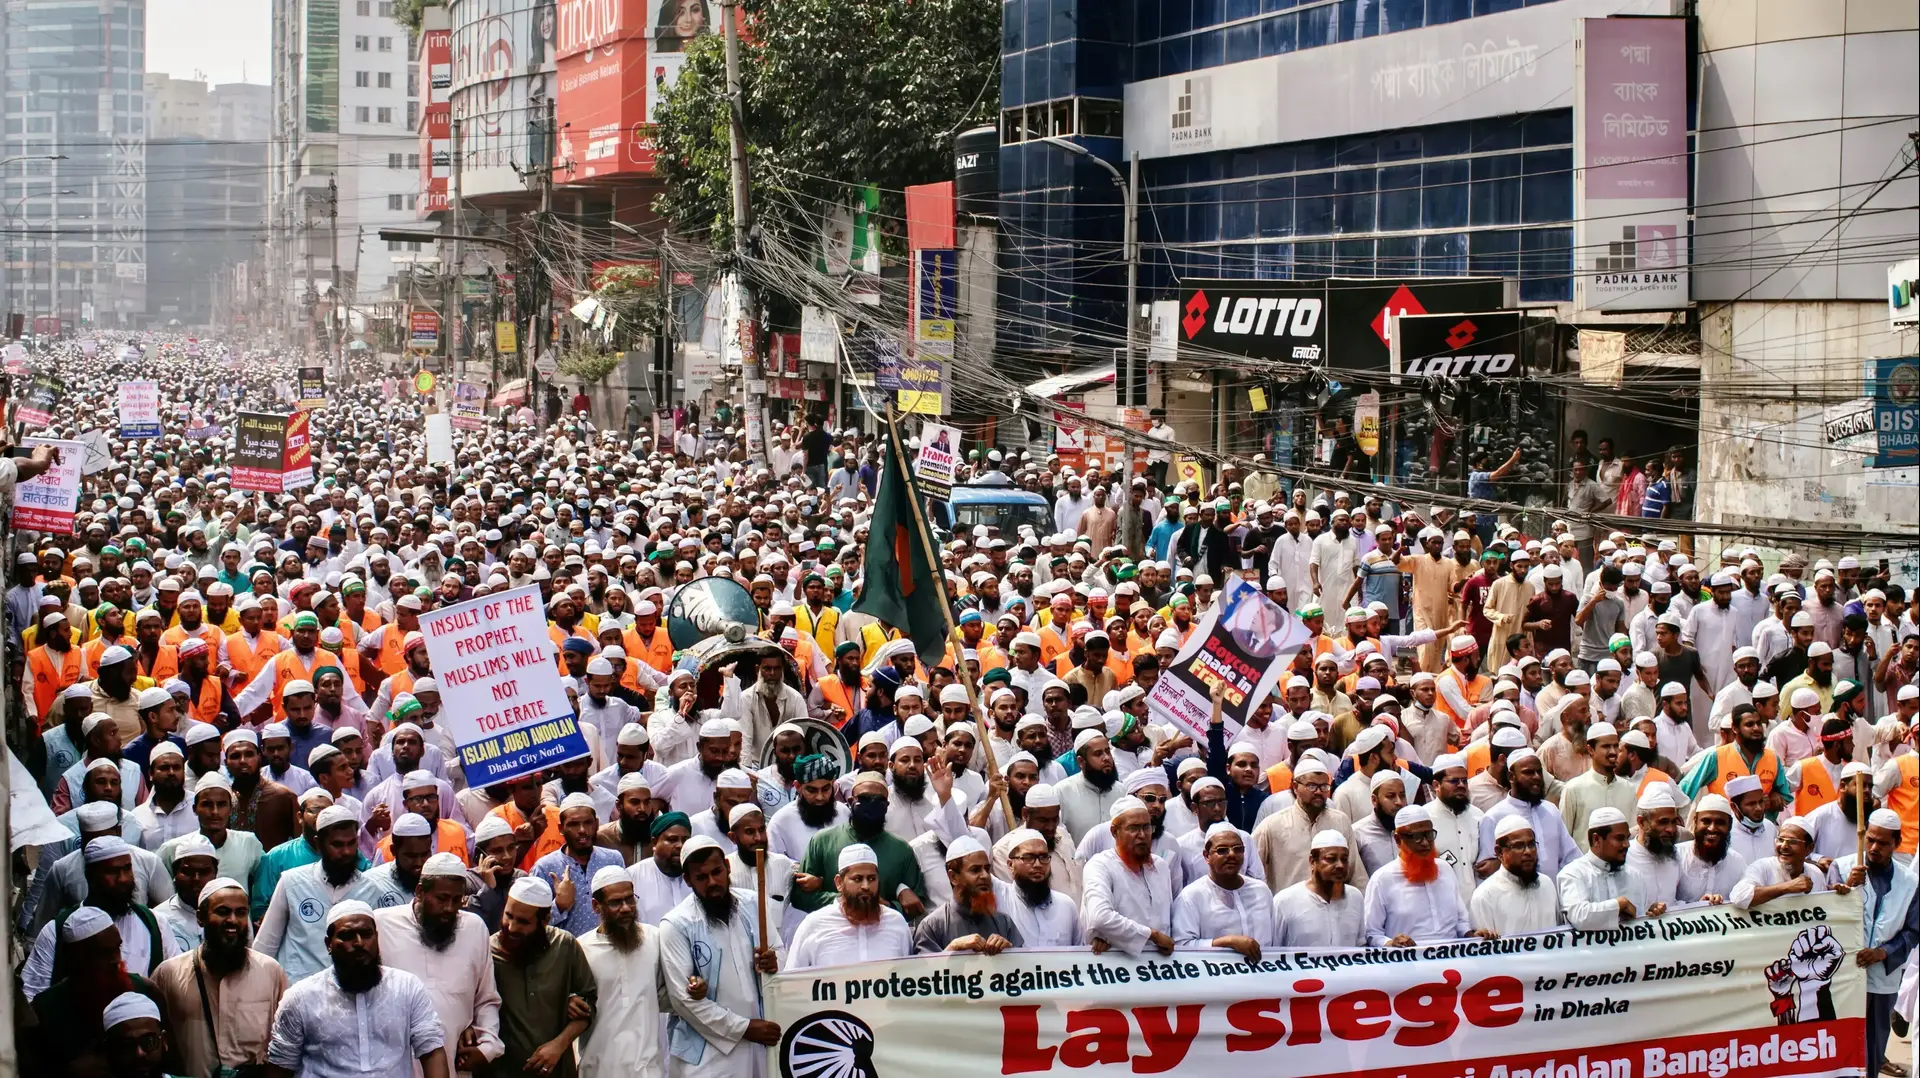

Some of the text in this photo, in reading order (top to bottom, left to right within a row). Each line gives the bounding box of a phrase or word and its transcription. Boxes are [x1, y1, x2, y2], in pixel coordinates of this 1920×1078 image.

[430, 33, 451, 48] rin
[1621, 45, 1652, 64] পদ্মা
[1405, 59, 1456, 97] ব্যাংক
[1460, 36, 1538, 91] লিমিটেড
[1612, 82, 1659, 102] ব্যাংক
[1172, 127, 1212, 142] PADMA BANK
[1602, 113, 1670, 139] লিমিটেড
[956, 154, 977, 169] GAZI
[1593, 155, 1628, 166] LOCKER
[430, 191, 448, 206] rin
[1596, 273, 1678, 284] PADMA BANK
[1213, 297, 1322, 337] LOTTO
[901, 367, 939, 386] GOODYEAR
[1406, 353, 1516, 377] LOTTO
[303, 387, 322, 395] High
[456, 403, 480, 412] Boycott
[244, 418, 258, 428] الله
[240, 449, 256, 458] عيب
[257, 448, 267, 458] كل
[922, 446, 953, 465] France
[920, 459, 952, 474] promoting
[37, 474, 61, 486] সবার
[22, 493, 70, 507] মানবতার
[430, 595, 535, 637] INSULT OF THE
[455, 625, 524, 657] PROPHET,
[444, 647, 546, 688] MUSLIMS WILL
[1205, 636, 1262, 684] Boycott
[1188, 658, 1245, 708] Frace
[1197, 648, 1253, 696] made in
[491, 680, 519, 702] NOT
[476, 700, 548, 735] TOLERATE
[1152, 692, 1172, 710] Islami
[1169, 705, 1194, 727] Andolan
[1190, 721, 1208, 738] Bang
[462, 717, 577, 766] ISLAMI JUBO ANDOLAN
[488, 743, 565, 776] Dhaka City North
[845, 967, 984, 1005] protesting
[990, 962, 1083, 997] against
[1087, 960, 1132, 985] the
[1137, 960, 1200, 982] state
[1202, 953, 1293, 977] backed
[1294, 945, 1417, 971] Exposition
[1423, 935, 1536, 962] caricature
[1570, 922, 1656, 949] Prophet
[1659, 913, 1726, 943] (pbuh)
[1728, 911, 1746, 930] in
[1749, 904, 1827, 928] France
[1535, 958, 1735, 991] to French Embassy
[1533, 997, 1630, 1022] in Dhaka
[999, 968, 1524, 1075] Lay siege
[1643, 1029, 1837, 1078] Bangladesh
